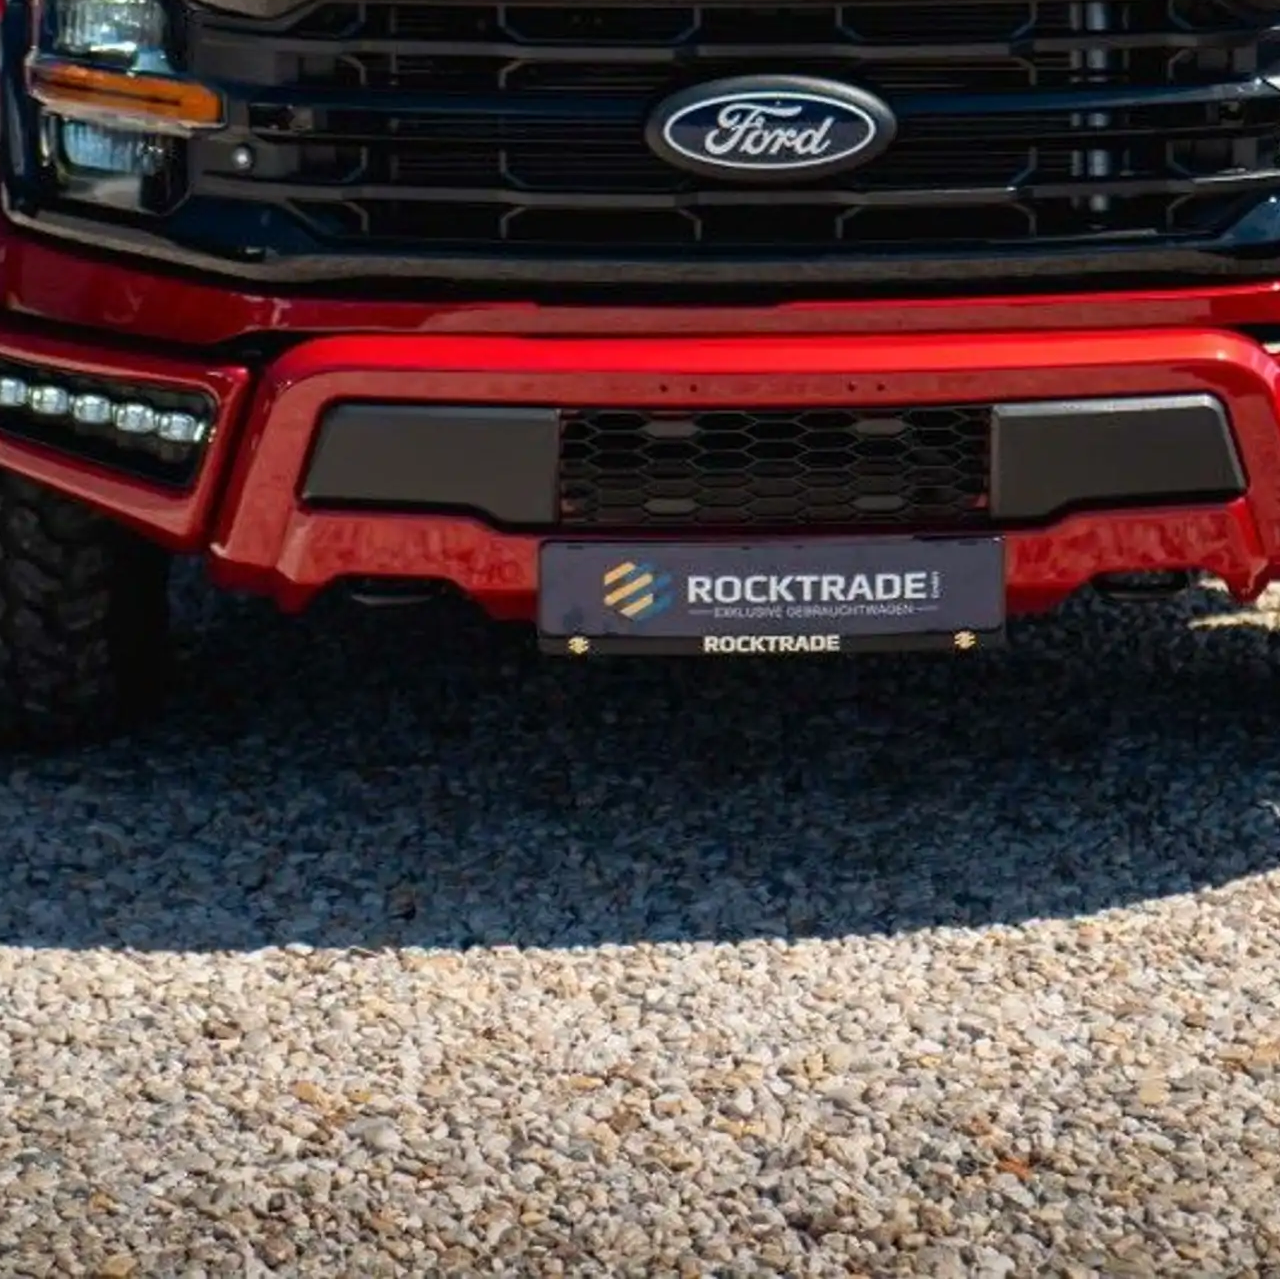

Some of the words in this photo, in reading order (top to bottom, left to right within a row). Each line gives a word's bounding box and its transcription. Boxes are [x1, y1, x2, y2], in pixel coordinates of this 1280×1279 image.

[704, 102, 835, 155] Ford
[688, 572, 927, 603] ROCKTRADE
[714, 607, 783, 619] EXKLUSIVE
[786, 604, 915, 618] GEBRAUCHTWAGEN
[704, 634, 841, 653] ROCKTRADE
